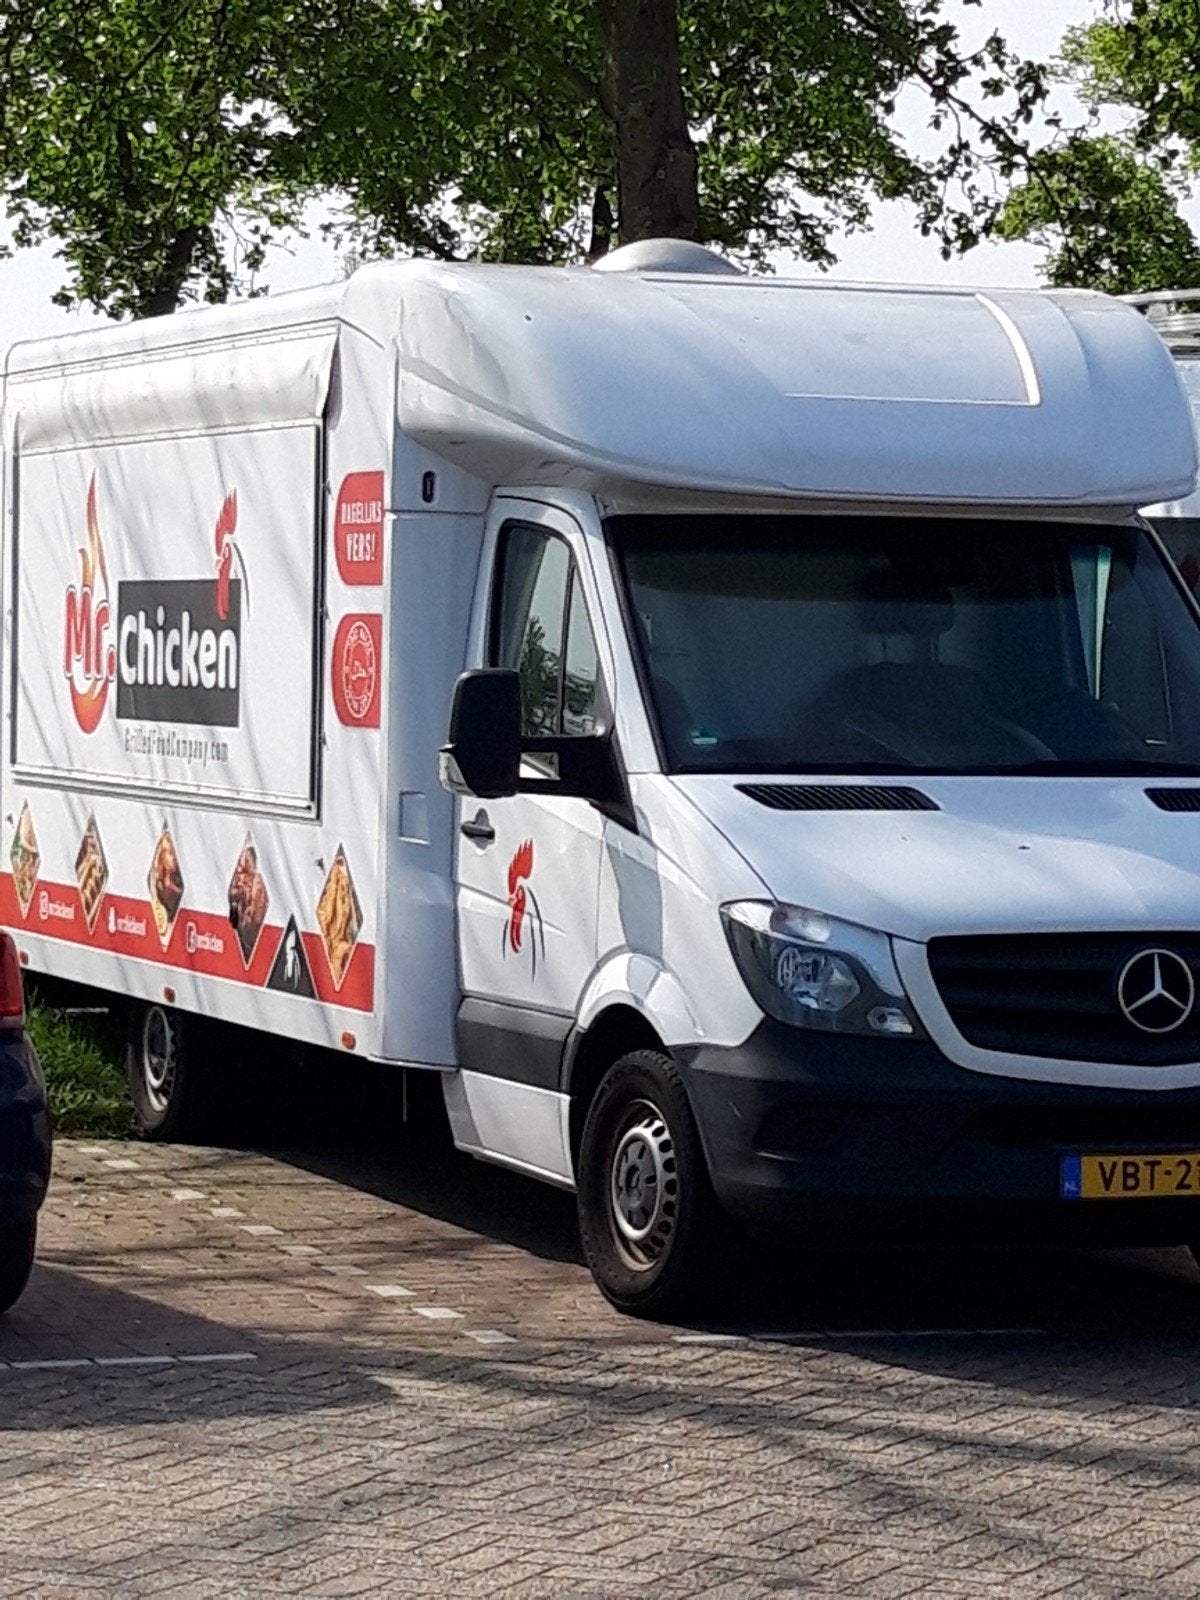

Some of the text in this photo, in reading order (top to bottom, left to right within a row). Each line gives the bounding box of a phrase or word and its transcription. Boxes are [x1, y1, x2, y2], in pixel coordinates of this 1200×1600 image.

[64, 585, 117, 682] Mr.
[119, 605, 238, 690] Chicken
[1098, 1159, 1200, 1192] VBT-2
